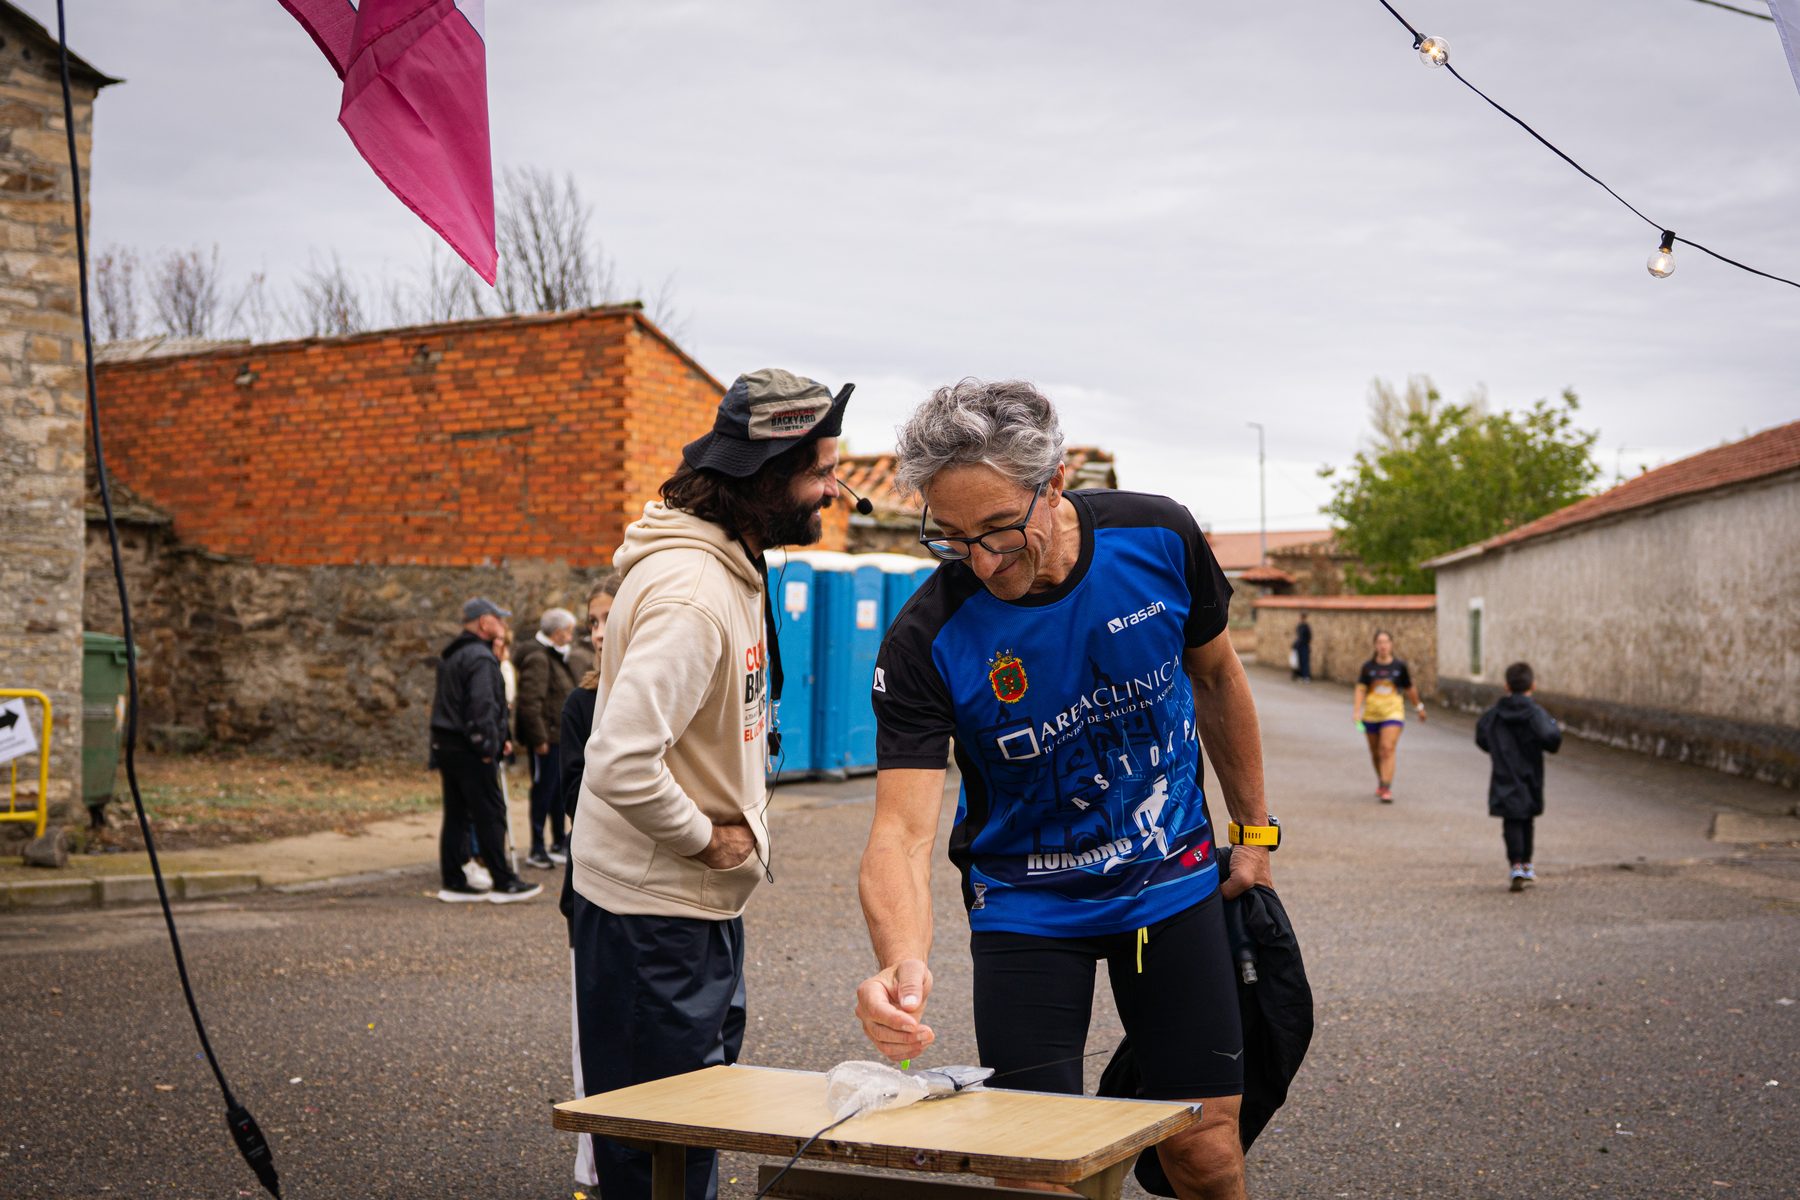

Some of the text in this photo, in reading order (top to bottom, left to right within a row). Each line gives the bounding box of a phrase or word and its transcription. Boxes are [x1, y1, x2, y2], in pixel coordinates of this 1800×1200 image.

[1123, 601, 1166, 628] rasán
[1043, 744, 1055, 754] TU
[1087, 715, 1101, 724] DE
[1104, 704, 1137, 720] SALUD
[1140, 698, 1153, 709] EN
